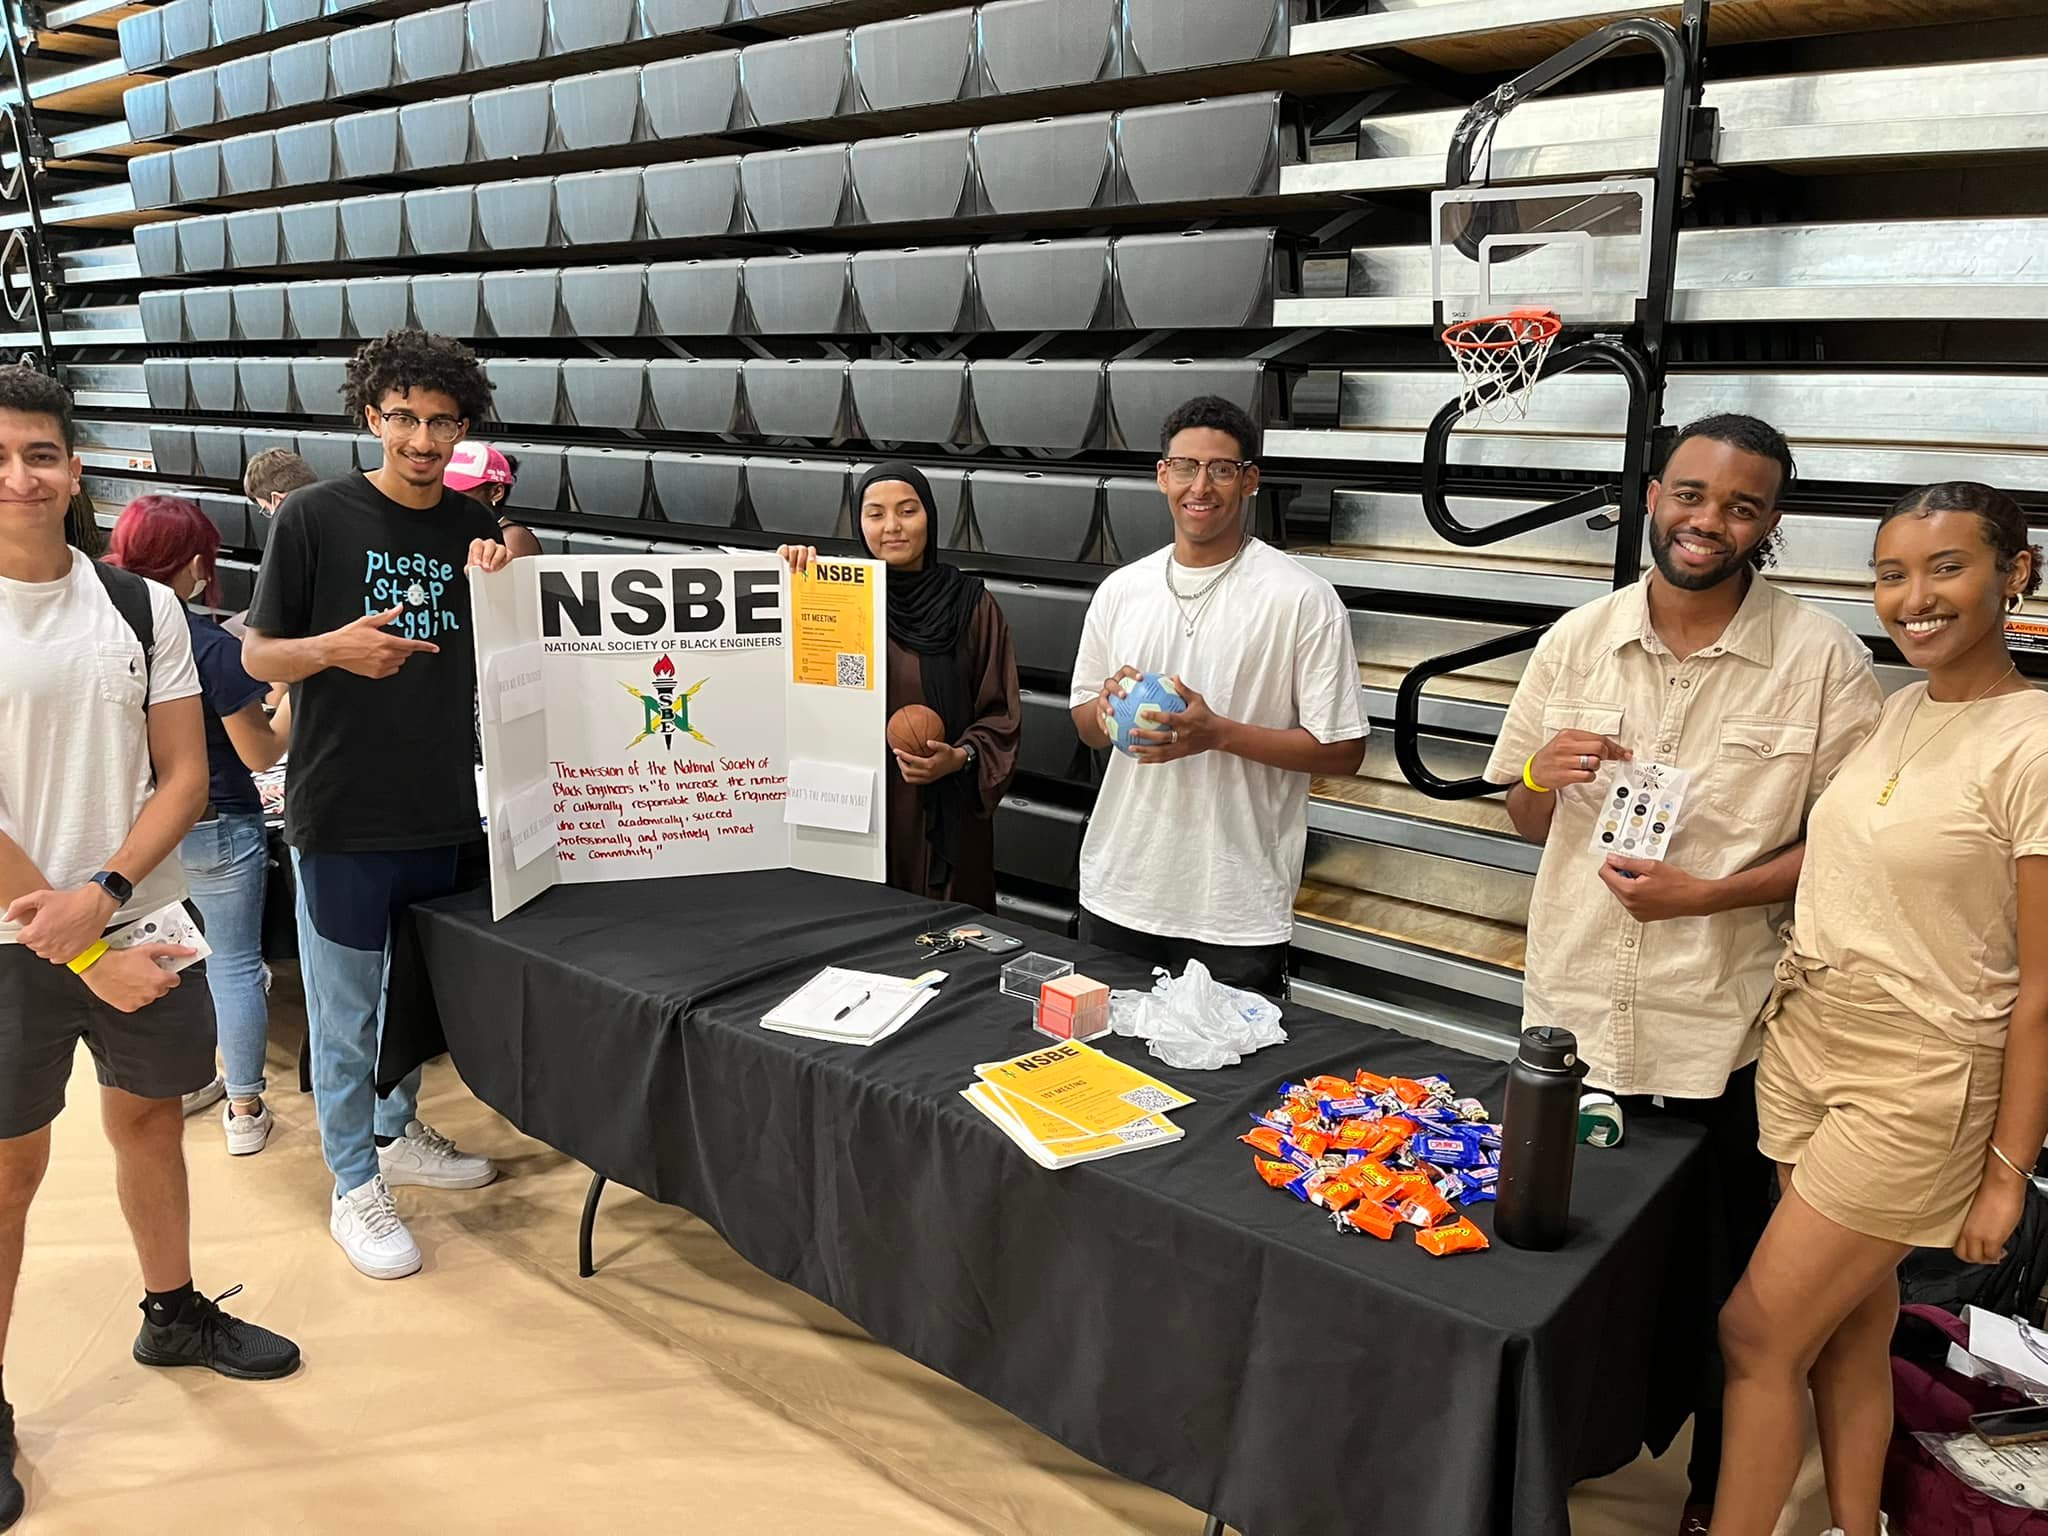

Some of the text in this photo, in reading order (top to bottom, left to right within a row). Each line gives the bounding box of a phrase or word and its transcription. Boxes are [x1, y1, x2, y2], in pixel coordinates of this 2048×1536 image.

[364, 550, 454, 584] please
[816, 564, 865, 584] NSBE
[539, 568, 783, 637] NSBE
[801, 613, 837, 624] 1ST MEETING
[544, 637, 782, 652] NATIONAL SOCIETY OF BLACK ENGINEERS
[550, 761, 578, 778] The
[628, 760, 640, 776] of
[647, 760, 668, 775] the
[674, 759, 715, 775] National
[720, 757, 755, 771] Society
[758, 757, 769, 769] of
[552, 782, 583, 797] Black
[639, 784, 649, 792] is
[676, 779, 719, 790] increase
[727, 776, 746, 787] the
[750, 775, 788, 785] number
[553, 789, 787, 816] of culturally responsible Black Engineers
[557, 820, 575, 831] who
[579, 819, 606, 830] excel
[692, 808, 733, 821] succeed
[638, 829, 658, 843] and
[556, 851, 576, 861] the
[1015, 1046, 1079, 1072] NSBE
[1054, 1079, 1088, 1095] MEETING
